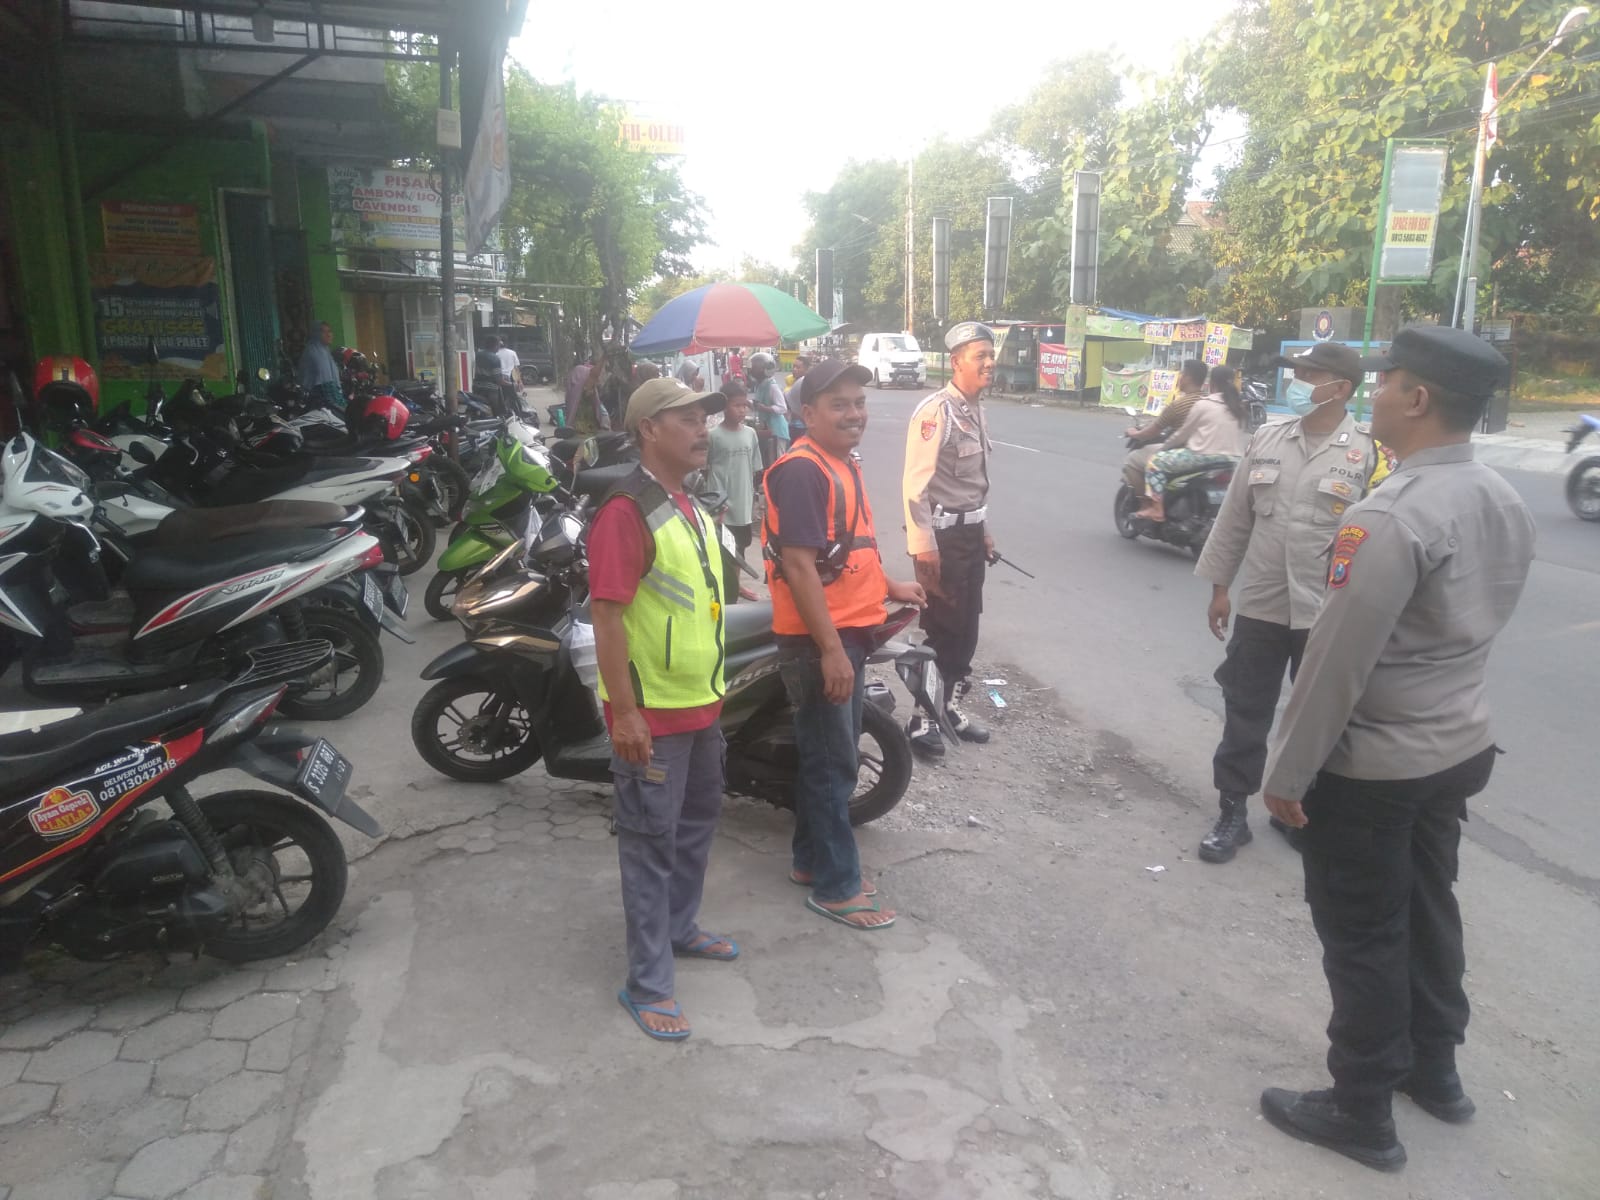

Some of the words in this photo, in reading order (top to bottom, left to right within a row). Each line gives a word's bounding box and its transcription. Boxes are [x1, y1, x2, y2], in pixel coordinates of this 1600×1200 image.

[103, 296, 124, 318] 15
[104, 768, 136, 788] DELIVERY
[137, 757, 162, 772] ORDER
[308, 781, 320, 794] S
[36, 809, 59, 822] Ayam
[59, 796, 88, 813] Geprek
[47, 810, 88, 830] LAYLA
